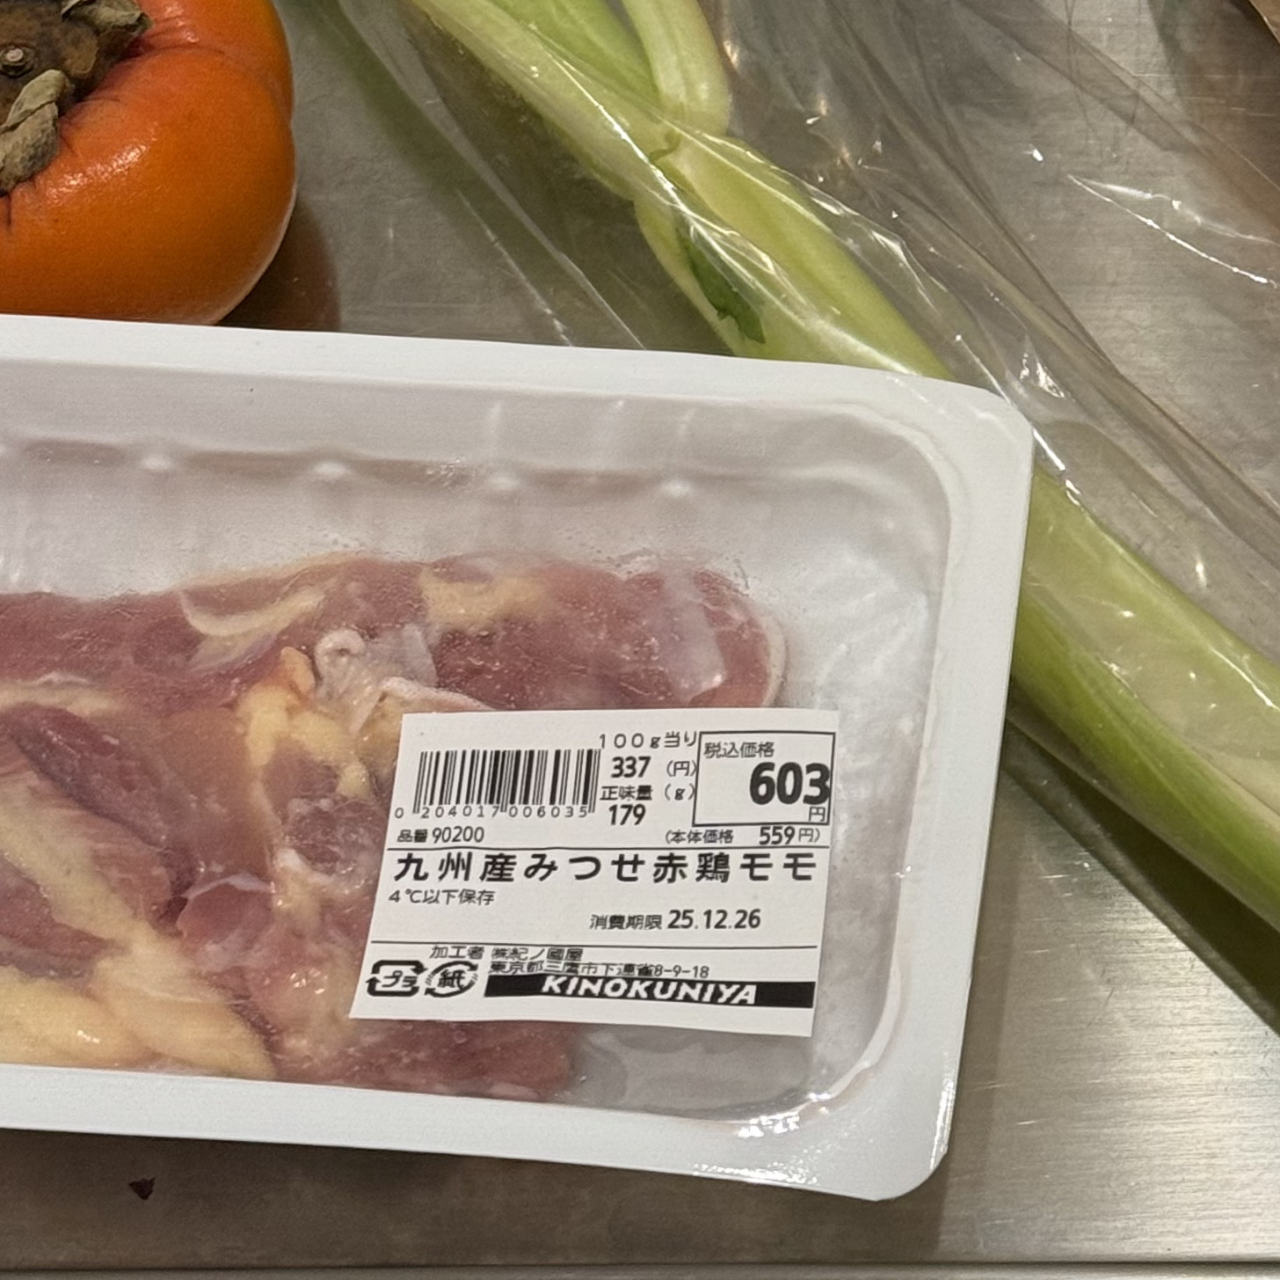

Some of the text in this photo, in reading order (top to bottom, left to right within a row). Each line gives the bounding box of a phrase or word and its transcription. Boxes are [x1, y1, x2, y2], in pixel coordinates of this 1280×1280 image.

[599, 731, 698, 750] 100g当り
[703, 741, 775, 759] 税込価格
[610, 756, 651, 778] 337
[600, 785, 653, 801] 正味量
[749, 761, 831, 805] 603
[395, 806, 405, 819] 0
[607, 803, 647, 826] 179
[808, 806, 827, 822] 円
[396, 826, 485, 844] 品番 90200
[758, 825, 796, 846] 559
[393, 851, 817, 883] 九州産みつせ赤鶏モモ
[589, 908, 761, 930] 消費期限 25.12.26
[429, 945, 485, 960] 加工者
[381, 971, 418, 988] プラ
[437, 969, 466, 990] 紙
[541, 975, 758, 1005] KINOKUNIYA
